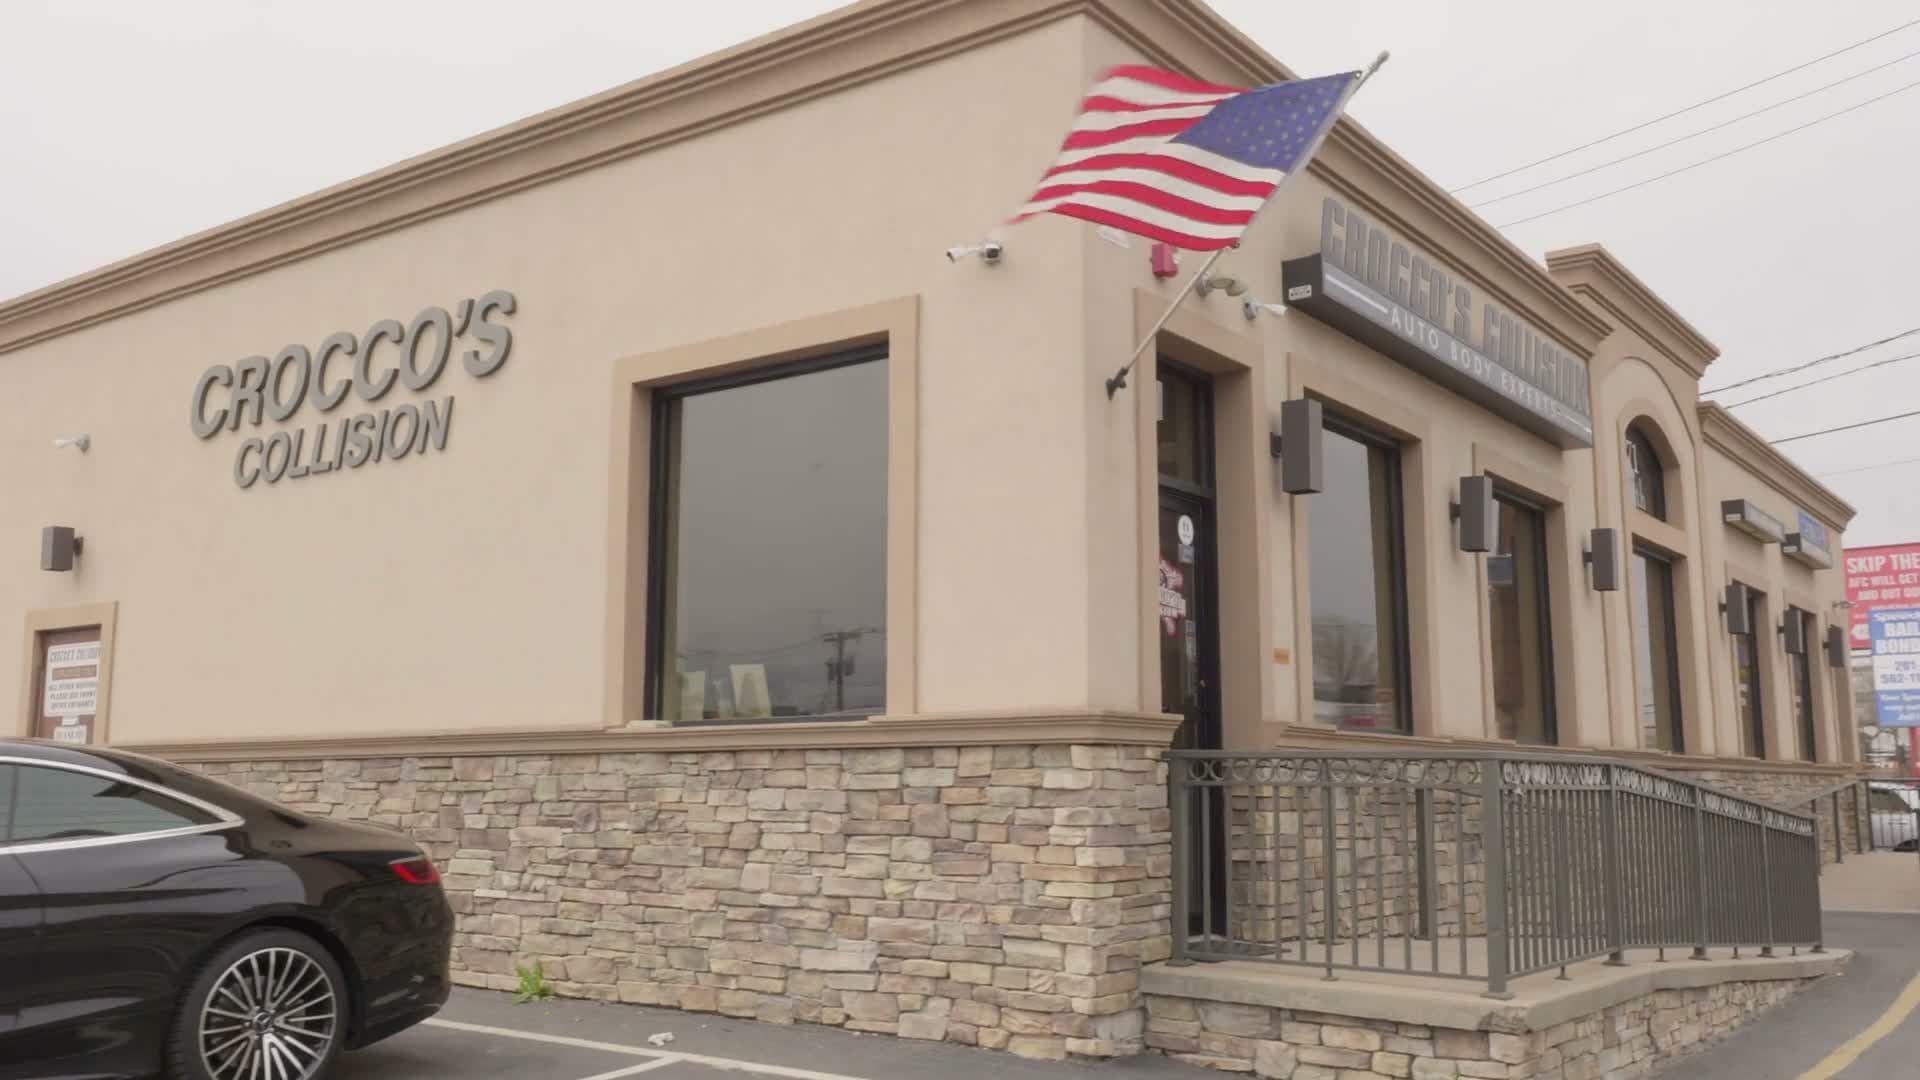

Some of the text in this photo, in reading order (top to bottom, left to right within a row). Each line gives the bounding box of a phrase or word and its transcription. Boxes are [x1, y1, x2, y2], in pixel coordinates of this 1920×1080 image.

[1321, 197, 1590, 416] CROCCO'S COLLISION
[1390, 306, 1560, 417] AUTO BODY EXPERTS
[190, 289, 518, 441] CROCCO'S
[233, 395, 456, 489] COLLISION
[1847, 552, 1920, 574] SKIP THE
